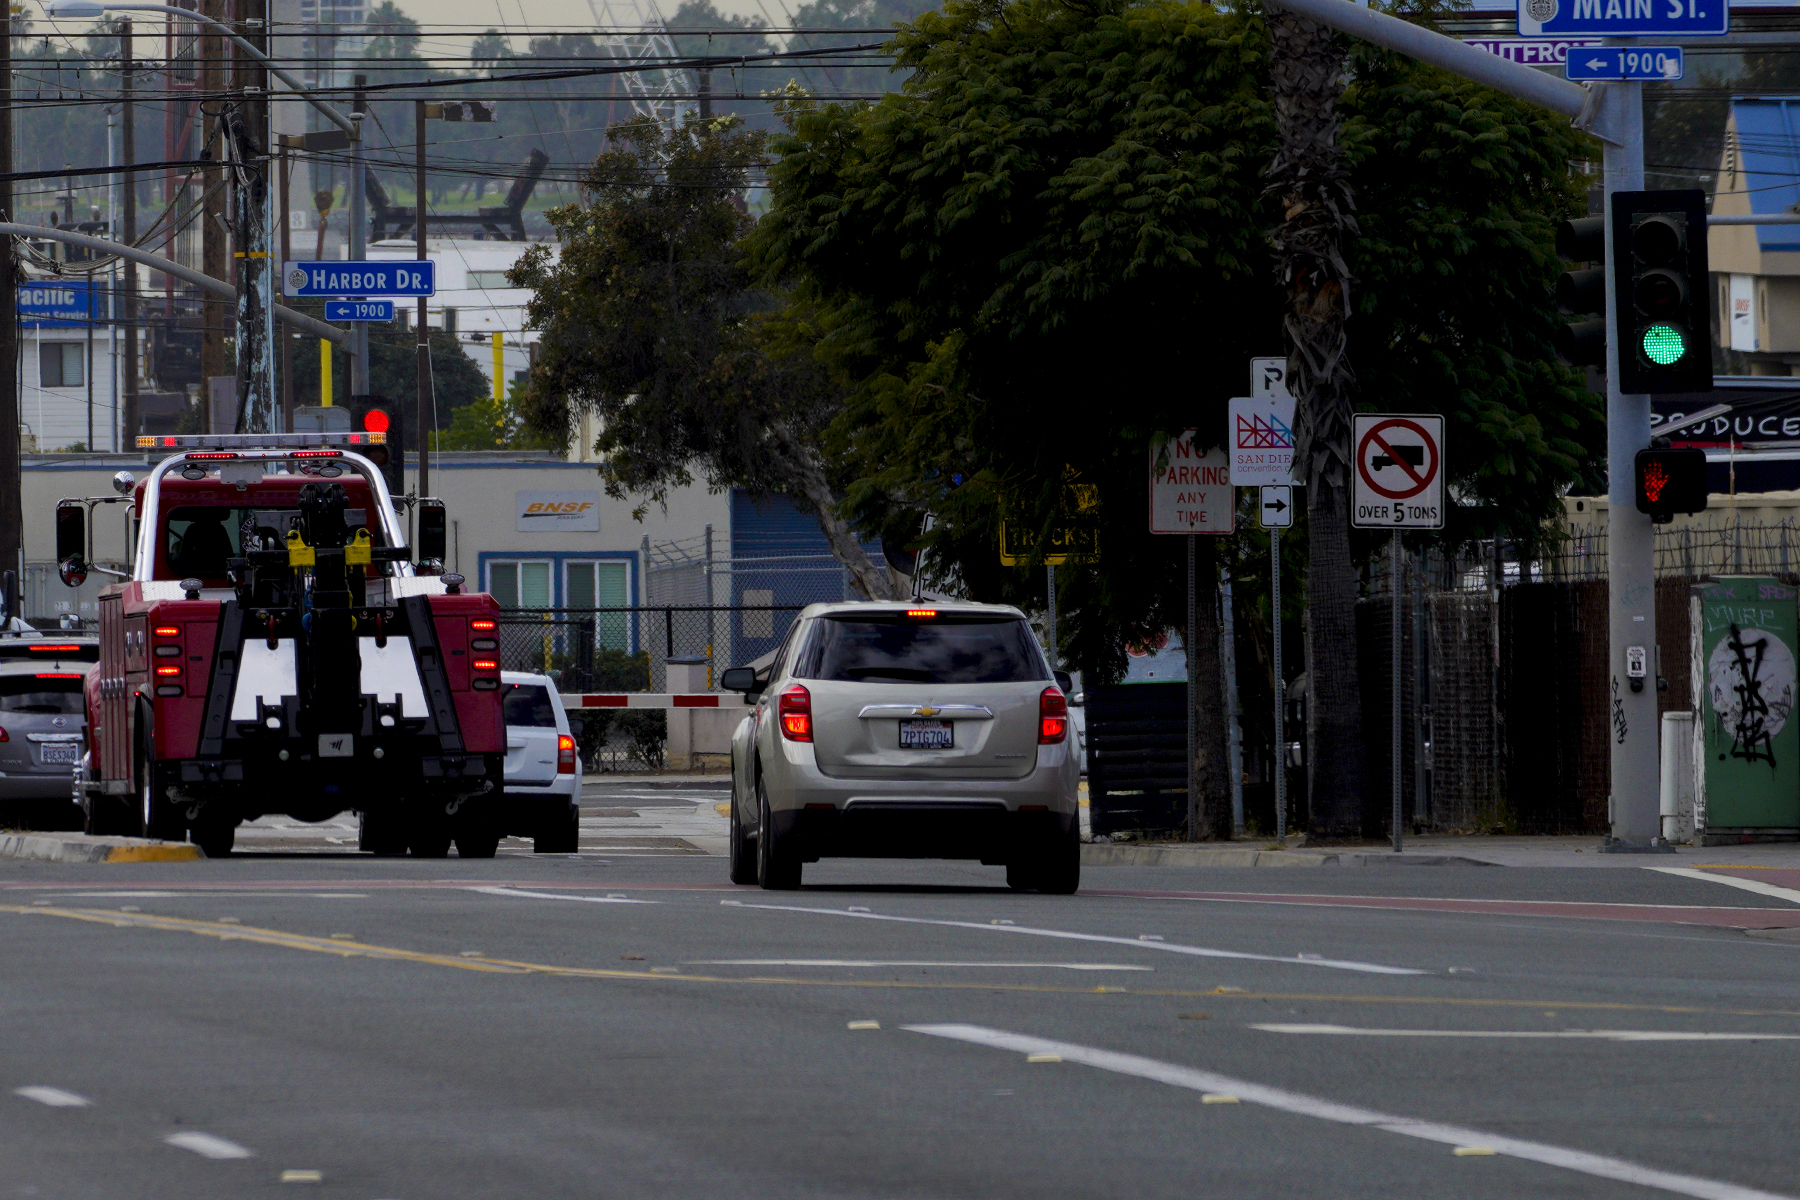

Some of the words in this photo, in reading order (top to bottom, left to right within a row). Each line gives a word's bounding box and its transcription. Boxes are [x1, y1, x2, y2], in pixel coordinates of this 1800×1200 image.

[1617, 52, 1668, 74] 1900
[312, 269, 387, 290] HARBOR
[355, 304, 385, 317] 1900
[1237, 454, 1265, 464] SAN
[1156, 466, 1229, 486] PARKING
[1176, 492, 1207, 505] ANY
[526, 502, 594, 513] BNSF
[1358, 505, 1389, 519] OVER
[1393, 502, 1404, 522] 5
[1408, 505, 1437, 519] TONS
[1176, 510, 1207, 523] TIME
[903, 730, 950, 744] 7PTG704
